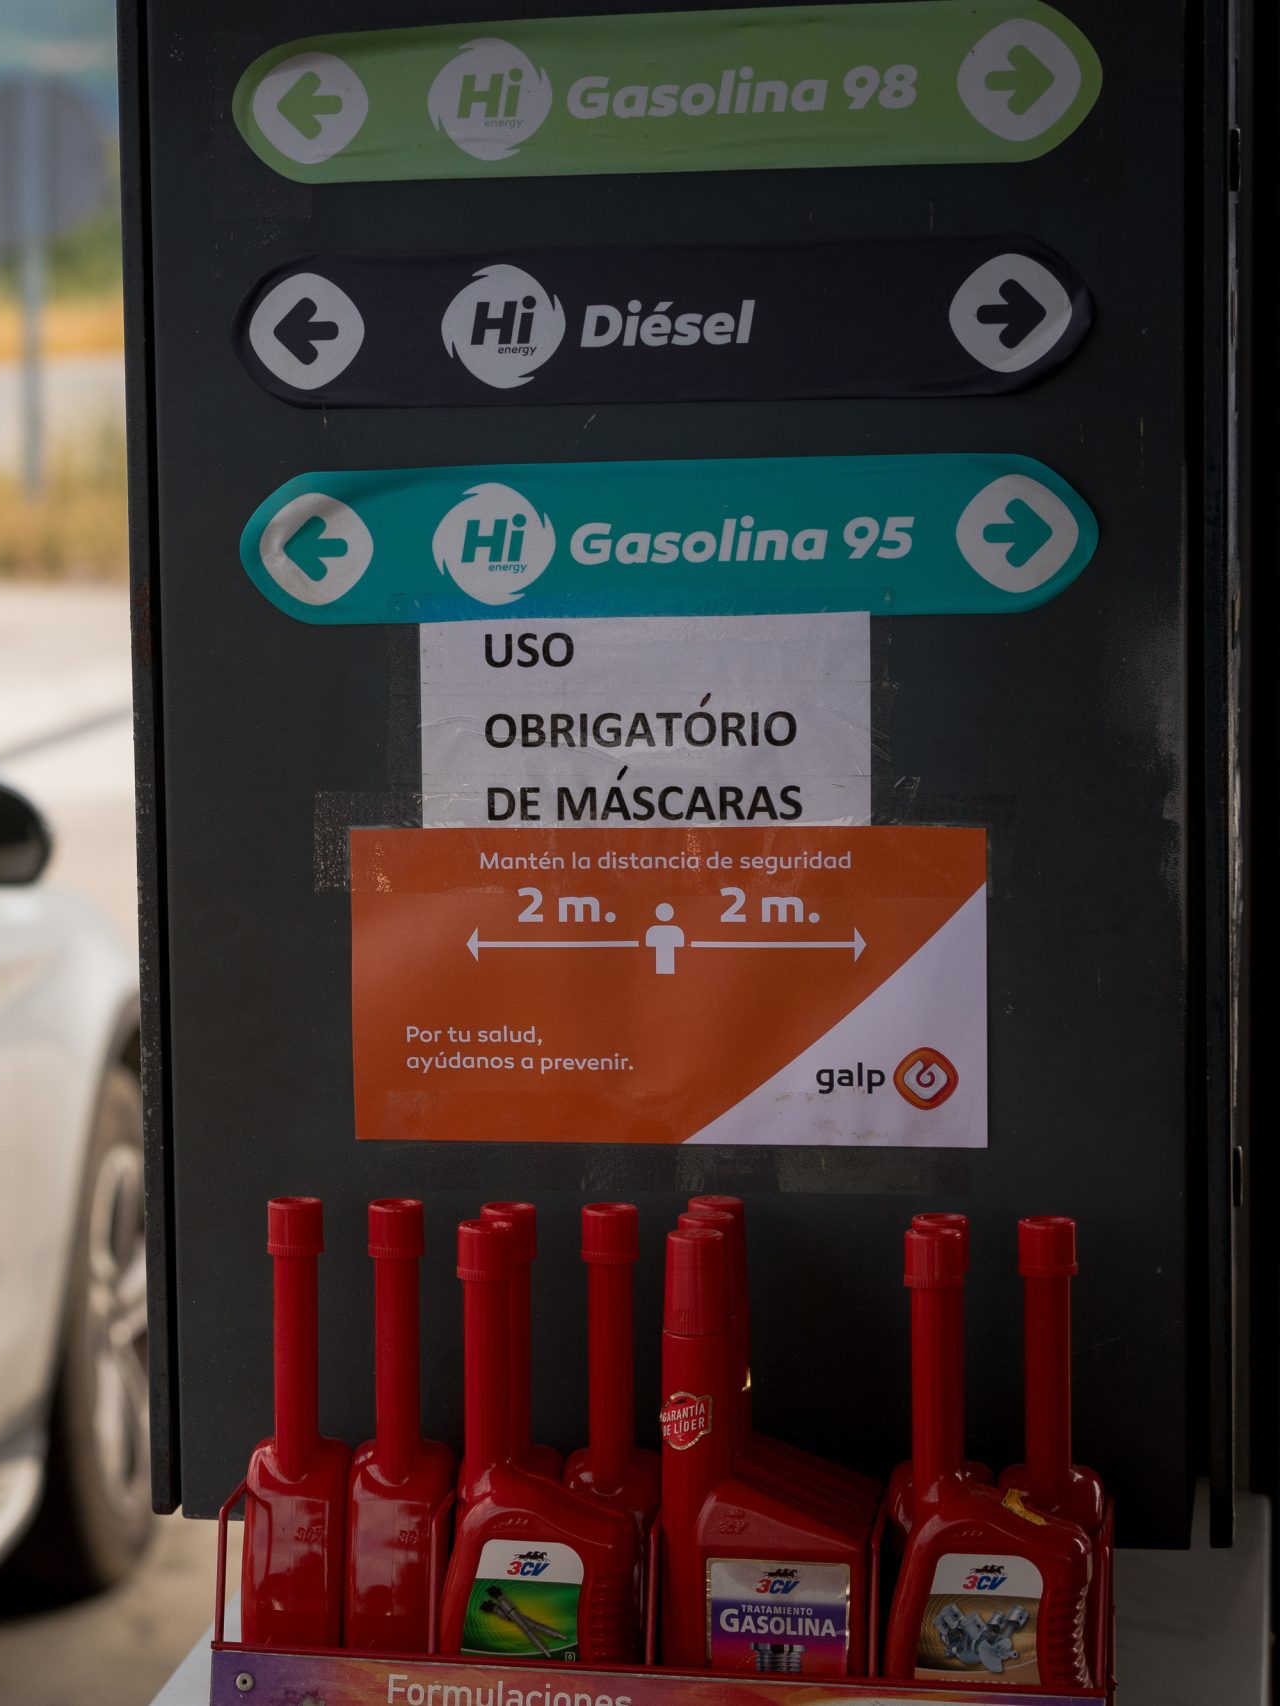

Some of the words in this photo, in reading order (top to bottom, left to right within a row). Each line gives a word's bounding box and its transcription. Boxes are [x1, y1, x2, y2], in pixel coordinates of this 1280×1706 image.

[458, 68, 522, 118] Hi
[567, 67, 828, 119] Gasolina
[844, 64, 917, 109] 98
[484, 118, 523, 129] energy
[471, 296, 536, 345] Hi
[581, 300, 755, 347] Diésel
[498, 345, 536, 356] energy
[462, 514, 526, 562] Hi
[570, 516, 827, 565] Gasolina
[844, 517, 914, 559] 95
[489, 563, 527, 573] energy
[485, 633, 574, 668] USO
[485, 693, 796, 748] OBRIGATÓRIO
[488, 787, 540, 821] DE
[558, 766, 802, 820] MÁSCARAS
[480, 852, 564, 869] Mantén
[573, 852, 590, 869] la
[598, 851, 698, 869] distancia
[706, 851, 732, 869] de
[740, 851, 851, 874] seguridad
[518, 887, 543, 922] 2
[559, 897, 616, 922] m.
[720, 887, 746, 922] 2
[762, 897, 819, 923] m.
[406, 1026, 441, 1043] Por
[448, 1027, 470, 1042] tu
[478, 1026, 542, 1045] salud,
[407, 1052, 514, 1073] ayúdanos
[521, 1057, 533, 1069] a
[541, 1053, 633, 1074] prevenir.
[816, 1063, 885, 1094] galp
[662, 1403, 706, 1423] GARANTÍA
[663, 1425, 671, 1437] DE
[673, 1417, 705, 1435] LÍDER
[506, 1560, 550, 1577] 3CV
[962, 1574, 1008, 1592] 3CV
[755, 1577, 802, 1595] 3CV
[718, 1608, 837, 1638] GASOLINA
[740, 1603, 814, 1616] TRATAMIENTO
